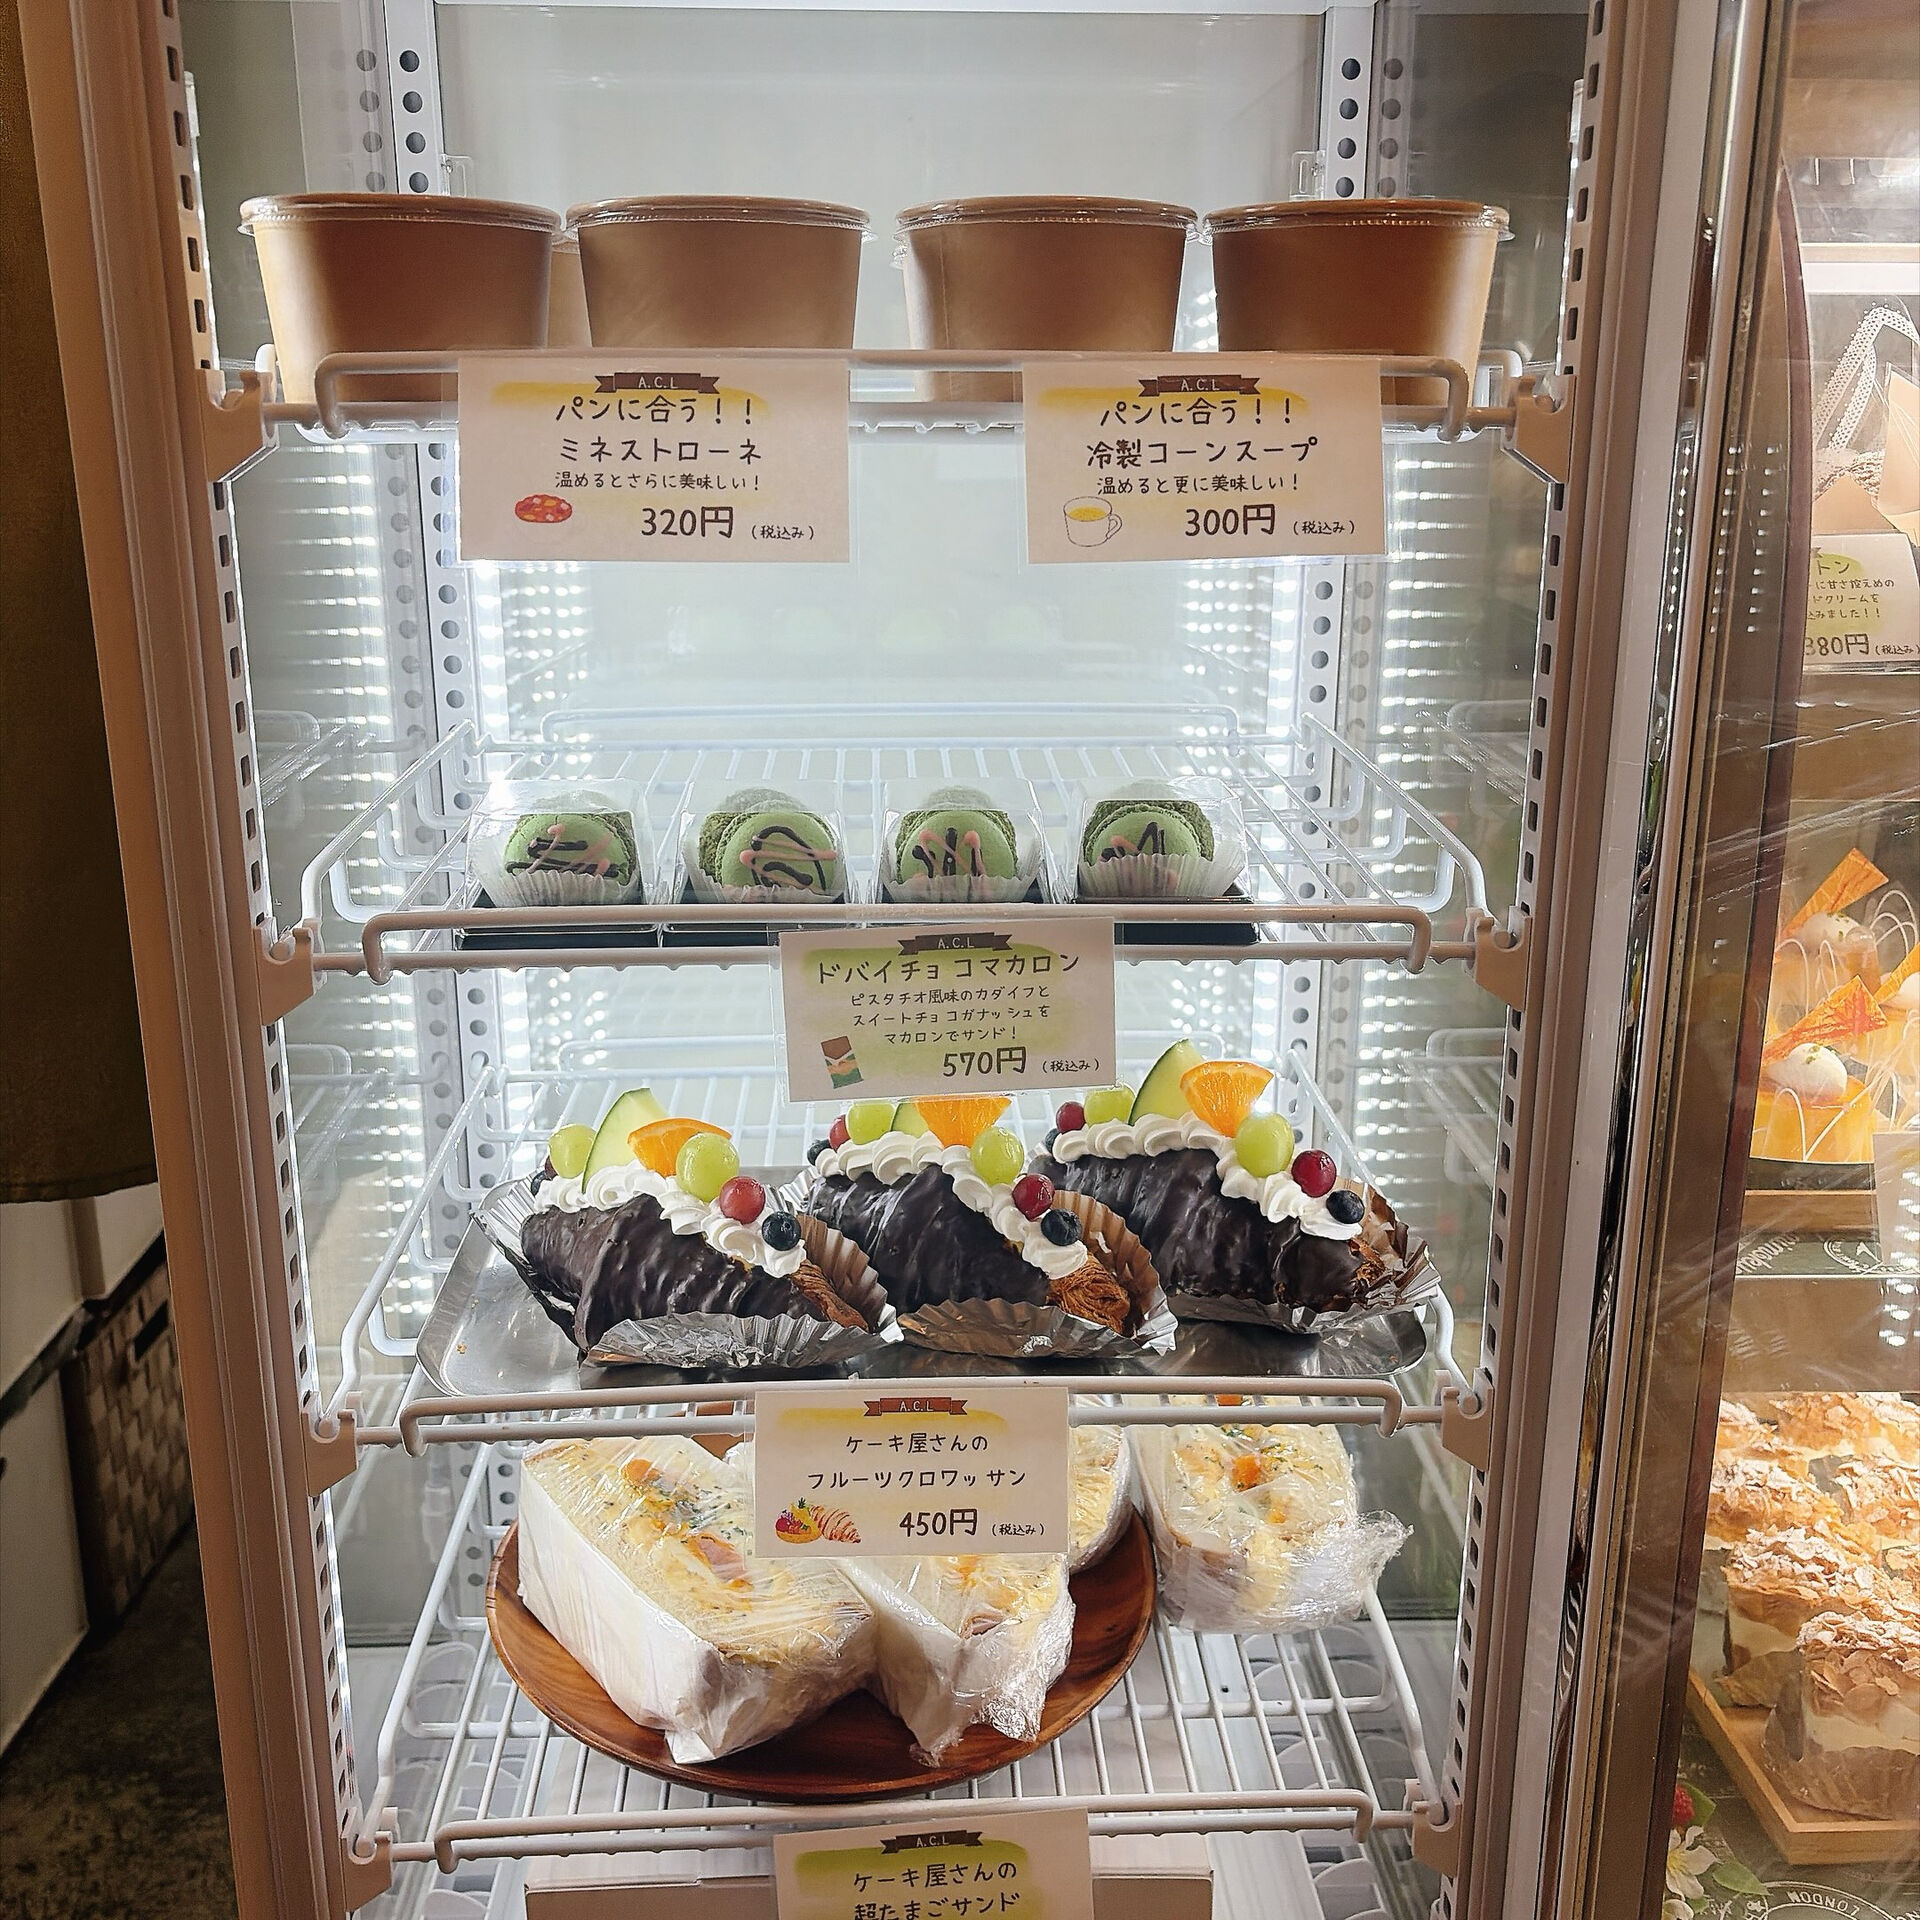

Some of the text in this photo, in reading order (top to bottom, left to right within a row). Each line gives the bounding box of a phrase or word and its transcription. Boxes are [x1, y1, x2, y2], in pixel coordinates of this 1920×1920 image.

[638, 375, 679, 390] A.C.L
[1180, 377, 1221, 392] A.C.L
[555, 394, 754, 425] パンに合う！！
[1100, 397, 1293, 427] パンに合う！！
[559, 436, 762, 466] ミネストローネ
[1086, 436, 1319, 469] 冷製コーンスープ
[555, 471, 761, 492] 温めるとさらに美味しい！
[1096, 473, 1299, 495] 温めると更に美味しい！
[641, 505, 735, 540] 320円
[1185, 503, 1277, 537] 300円
[1808, 579, 1895, 590] に甘さ控えめの
[937, 936, 975, 950] A.C.L
[817, 953, 1080, 985] ドバイチョコマカロン
[850, 984, 1051, 1007] ピスタチオ風味のカダイフと
[853, 1004, 1051, 1027] スイートチョコガナッシュを
[884, 1026, 1018, 1045] マカロンでサンド！
[942, 1046, 1028, 1078] 570円
[899, 1400, 934, 1413] A.C.L
[845, 1432, 989, 1455] ケーキ屋さんの
[807, 1469, 1027, 1491] フルーツクロワッサン
[899, 1508, 979, 1538] 450円
[915, 1834, 950, 1849] A.C.L
[853, 1862, 1018, 1893] ケーキ屋さんの
[854, 1892, 1021, 1920] 超たまごサンド
